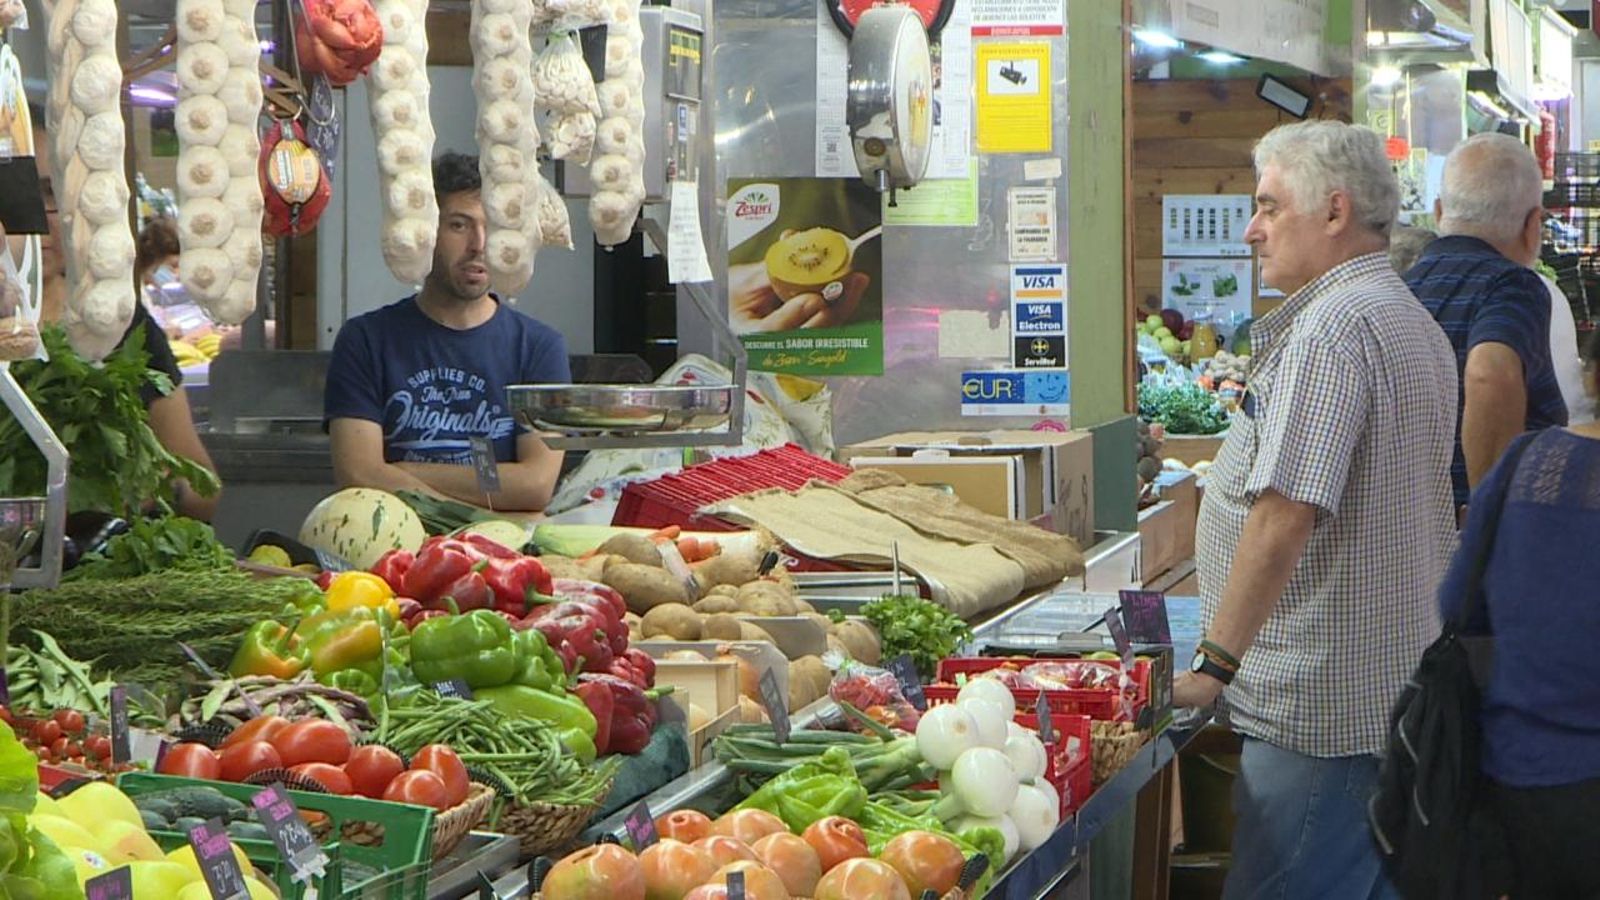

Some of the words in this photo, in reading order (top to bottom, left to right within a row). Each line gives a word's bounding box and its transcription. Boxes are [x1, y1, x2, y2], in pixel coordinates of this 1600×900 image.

[736, 201, 772, 217] Zespri
[1023, 276, 1055, 288] VISA
[1027, 304, 1052, 315] VISA
[1019, 321, 1060, 330] Electron
[785, 338, 814, 349] SABOR
[815, 338, 869, 348] IRRESISTIBLE
[408, 367, 465, 388] SUPPLIES
[421, 386, 443, 403] The
[383, 391, 494, 441] Originals
